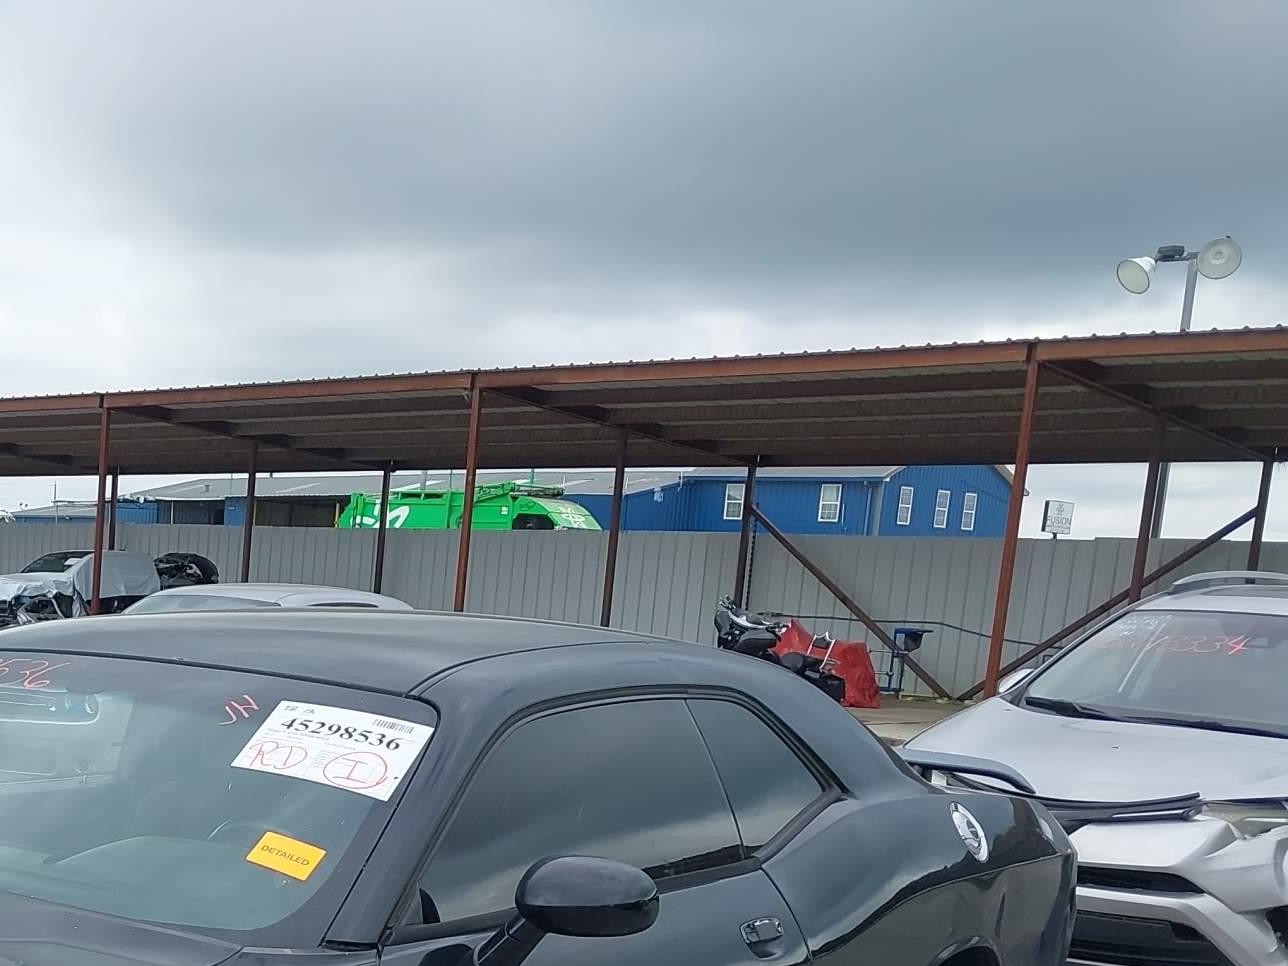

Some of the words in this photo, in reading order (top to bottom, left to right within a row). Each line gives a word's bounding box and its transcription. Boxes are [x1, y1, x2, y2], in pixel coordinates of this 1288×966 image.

[279, 716, 402, 751] 45298536
[248, 740, 309, 770] RD
[260, 844, 311, 867] DETAILED
